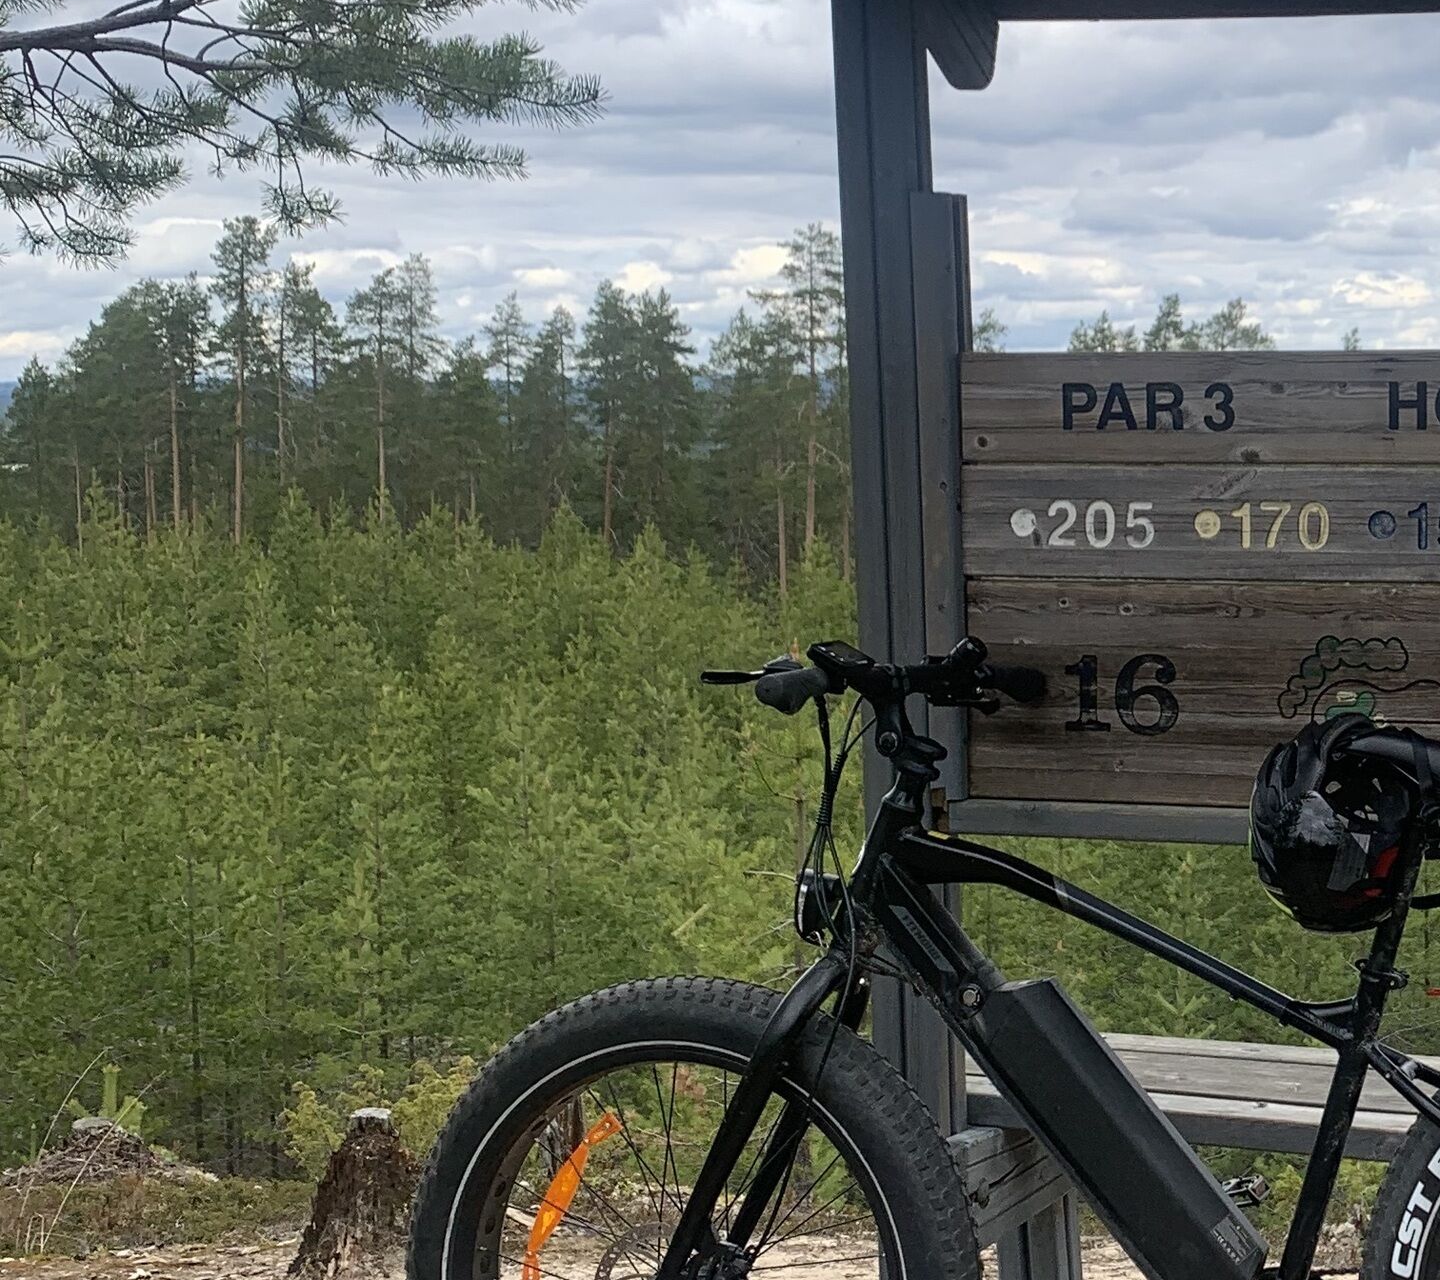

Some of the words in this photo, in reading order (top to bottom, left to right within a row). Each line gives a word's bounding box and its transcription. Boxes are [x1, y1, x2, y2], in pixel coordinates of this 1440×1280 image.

[1062, 381, 1185, 431] PAR
[1203, 381, 1236, 432] 3
[1047, 499, 1156, 549] 205
[1230, 500, 1330, 550] 170
[1063, 652, 1180, 737] 16
[1390, 1180, 1433, 1280] CST
